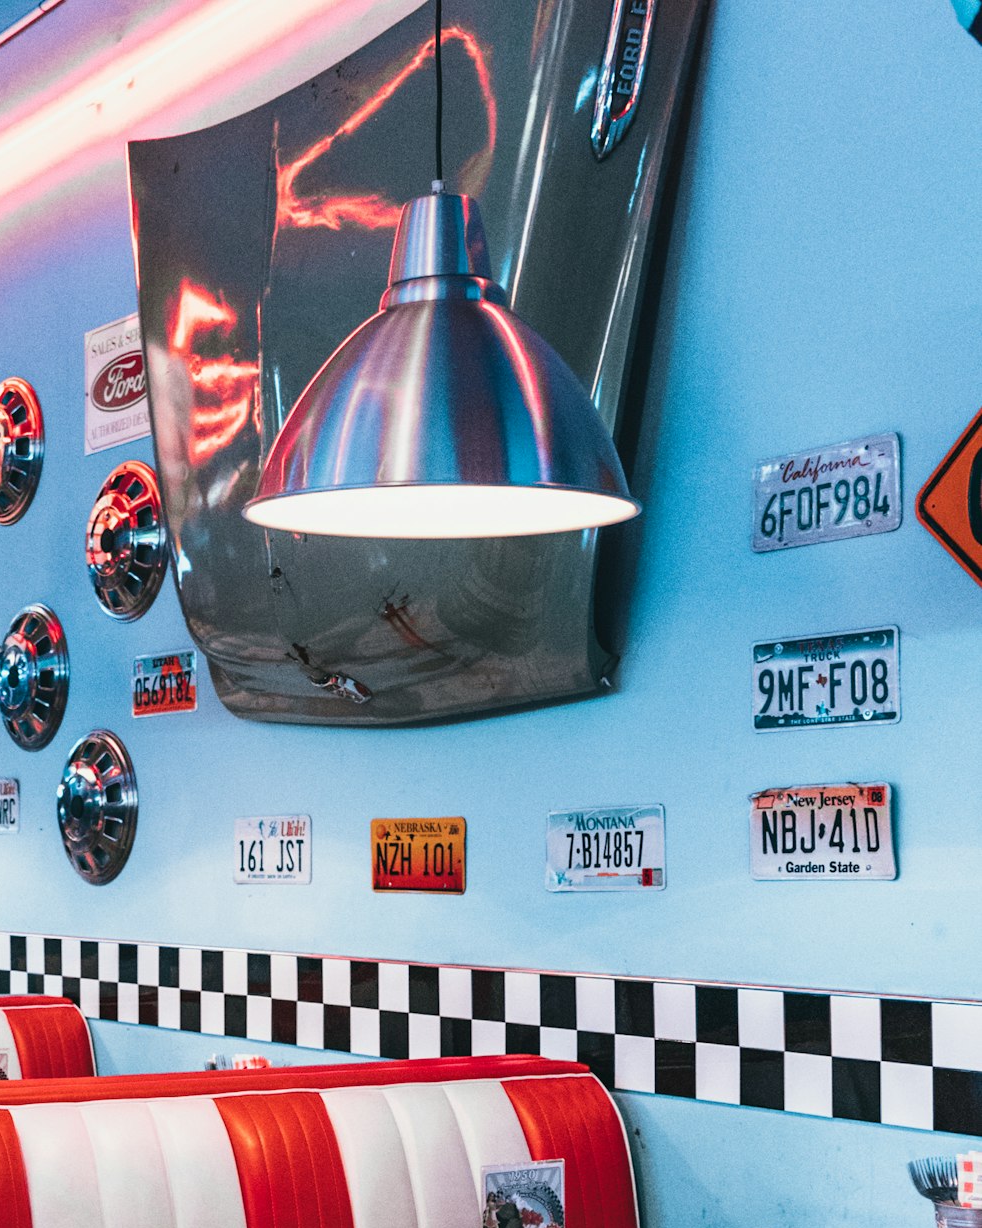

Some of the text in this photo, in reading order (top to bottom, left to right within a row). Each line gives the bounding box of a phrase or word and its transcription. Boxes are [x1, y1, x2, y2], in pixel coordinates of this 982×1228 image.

[616, 27, 643, 95] FORD
[125, 327, 141, 345] SER
[782, 455, 871, 483] California
[797, 637, 844, 654] TEXAS
[152, 656, 175, 668] UTAH
[804, 651, 841, 662] TRUCK
[787, 791, 856, 809] New Jersey
[394, 822, 442, 833] NEBRASKA
[575, 812, 636, 831] MONTANA
[239, 839, 304, 872] 161 JST
[376, 842, 454, 876] NZH 101
[785, 861, 861, 874] Garden State
